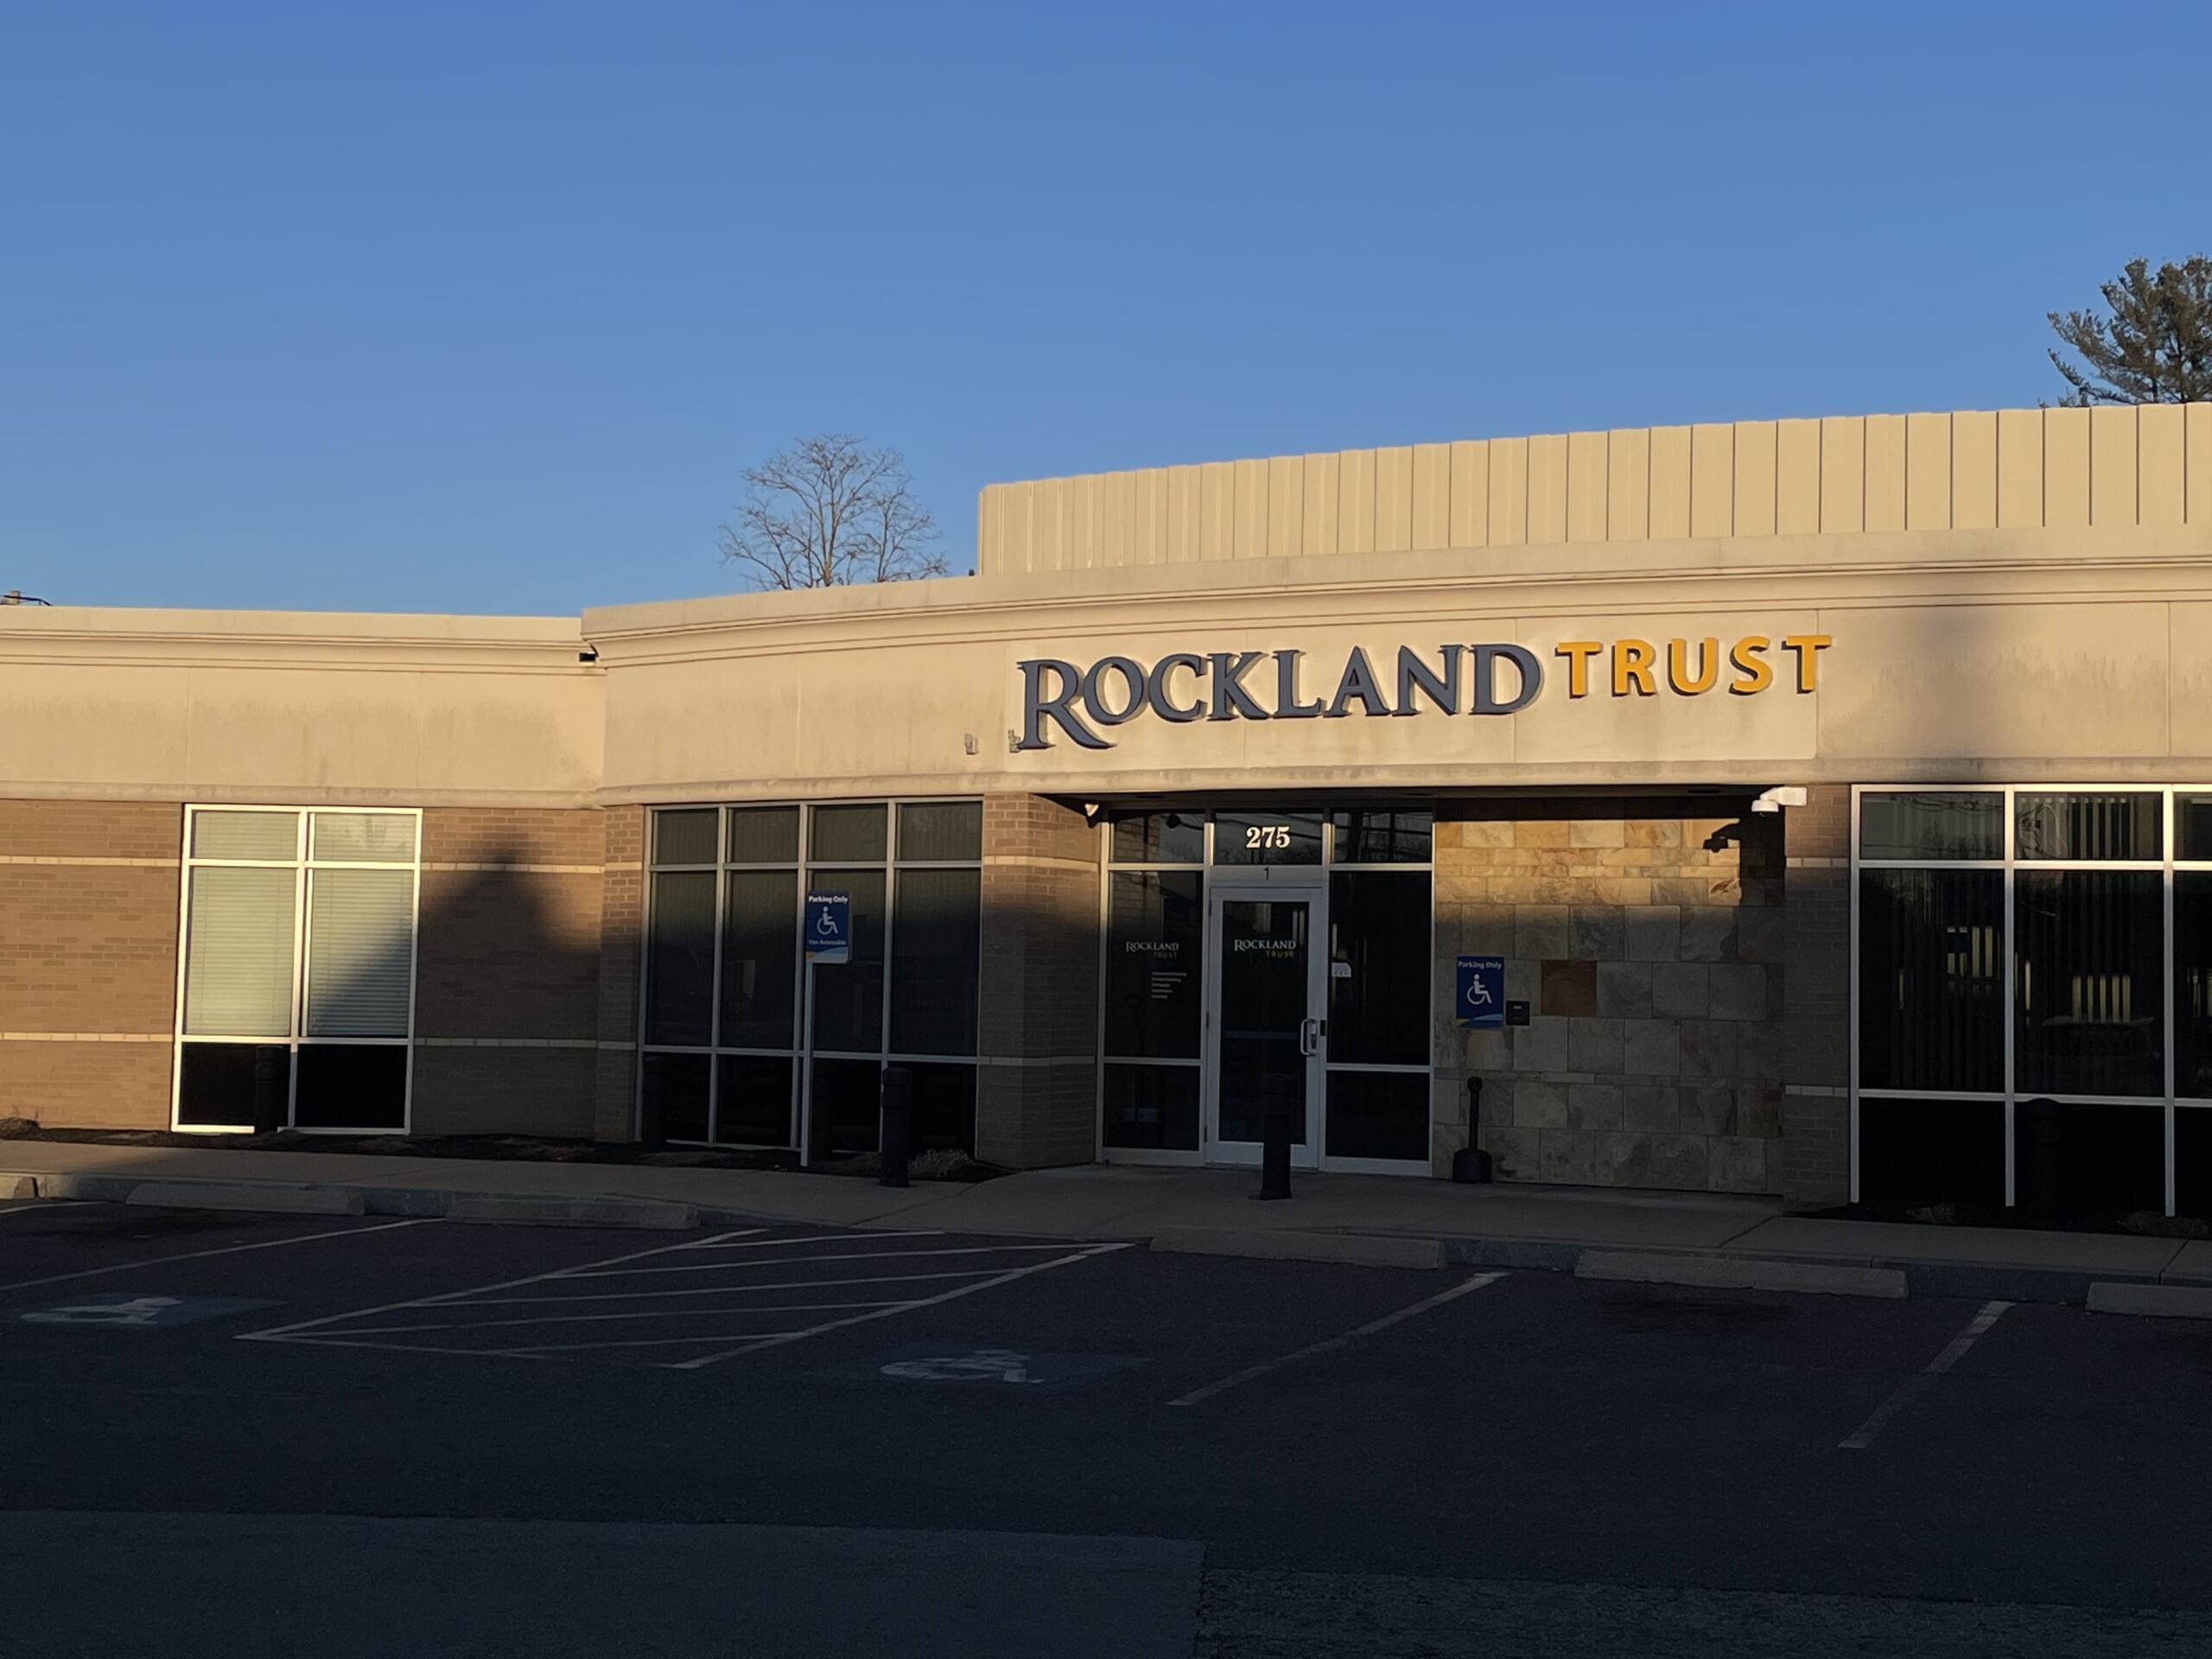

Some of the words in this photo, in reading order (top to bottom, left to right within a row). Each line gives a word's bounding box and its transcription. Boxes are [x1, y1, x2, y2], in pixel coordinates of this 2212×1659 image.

[1016, 643, 1543, 750] ROCKLAND
[1554, 635, 1832, 699] TRUST
[1246, 826, 1291, 849] 275
[1263, 867, 1269, 881] 1
[808, 895, 832, 905] Parking
[833, 895, 849, 905] Only
[1125, 941, 1180, 953] ROCKLAND
[1234, 938, 1297, 952] ROCKLAND
[1265, 950, 1295, 959] TRUST
[1458, 961, 1484, 969] Parking
[1485, 961, 1503, 970] Only
